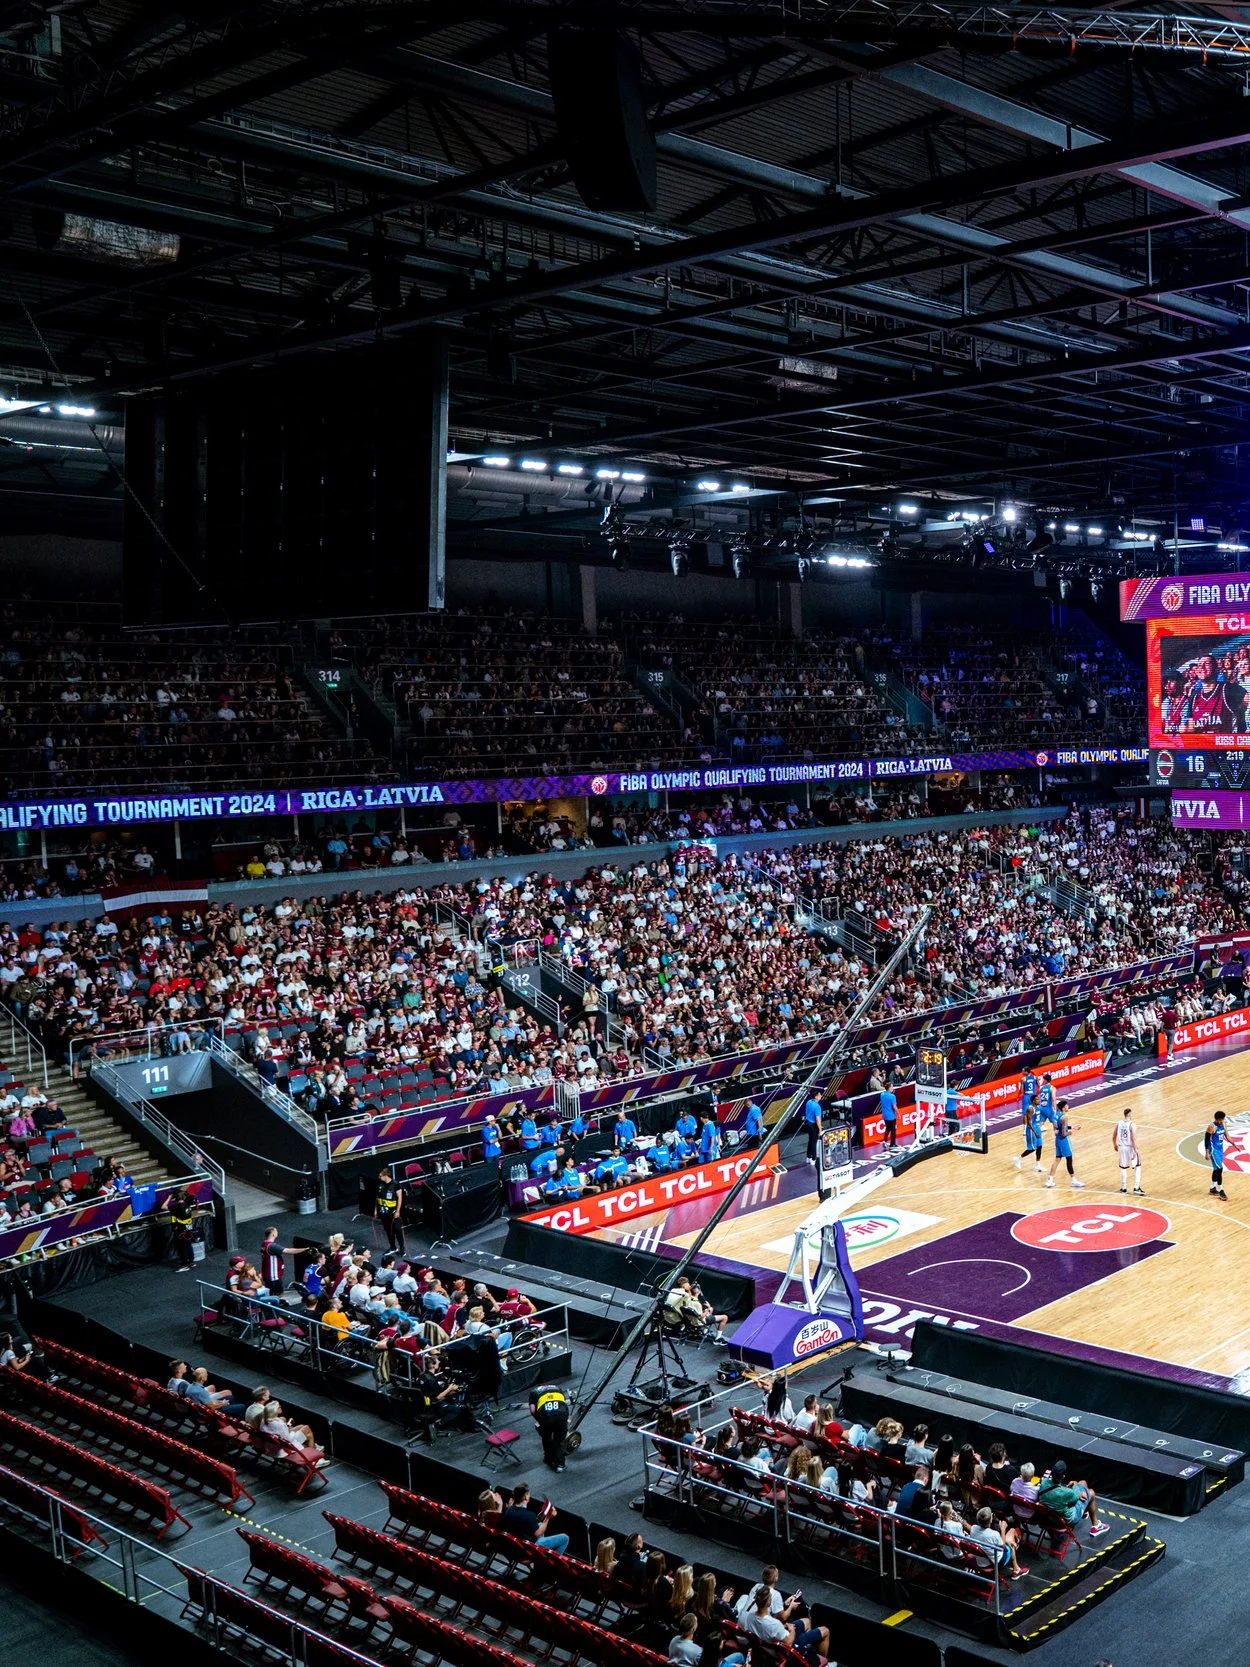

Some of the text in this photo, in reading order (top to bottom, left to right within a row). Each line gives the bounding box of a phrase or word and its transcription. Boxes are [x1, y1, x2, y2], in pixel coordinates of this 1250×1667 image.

[1189, 585, 1221, 605] FIBA
[1215, 617, 1250, 631] TCL
[318, 671, 341, 682] 314
[648, 672, 664, 682] 315
[874, 673, 887, 682] 316
[1056, 673, 1069, 682] 317
[1215, 736, 1234, 746] KISS
[1057, 751, 1078, 764] FIBA
[1080, 750, 1118, 763] OLYMPIC
[1226, 751, 1244, 760] 2:19
[1186, 755, 1205, 772] 16
[620, 775, 648, 791] FIBA
[651, 772, 701, 789] OLYMPIC
[704, 768, 766, 787] QUALIFYING
[769, 764, 836, 781] TOURNAMENT
[838, 762, 863, 778] 2024
[94, 796, 224, 822] TOURNAMENT
[228, 794, 276, 814] 2024
[823, 925, 838, 936] 113
[509, 973, 530, 991] 112
[1165, 1029, 1192, 1045] CL
[1195, 1020, 1220, 1039] TCL
[1223, 1011, 1247, 1030] TCL
[923, 1053, 942, 1064] 2:19
[142, 1065, 169, 1084] 111
[925, 1090, 942, 1098] TISSOT
[1027, 1082, 1033, 1092] 3
[865, 1119, 898, 1136] TC
[902, 1109, 926, 1126] ECO
[1071, 1057, 1102, 1075] mašīna
[1040, 1092, 1049, 1101] 24
[832, 1169, 850, 1179] TISSOT
[598, 1187, 653, 1217] TCL
[660, 1172, 712, 1199] TCL
[1037, 1211, 1142, 1243] TCL
[801, 1320, 829, 1340] 百岁山
